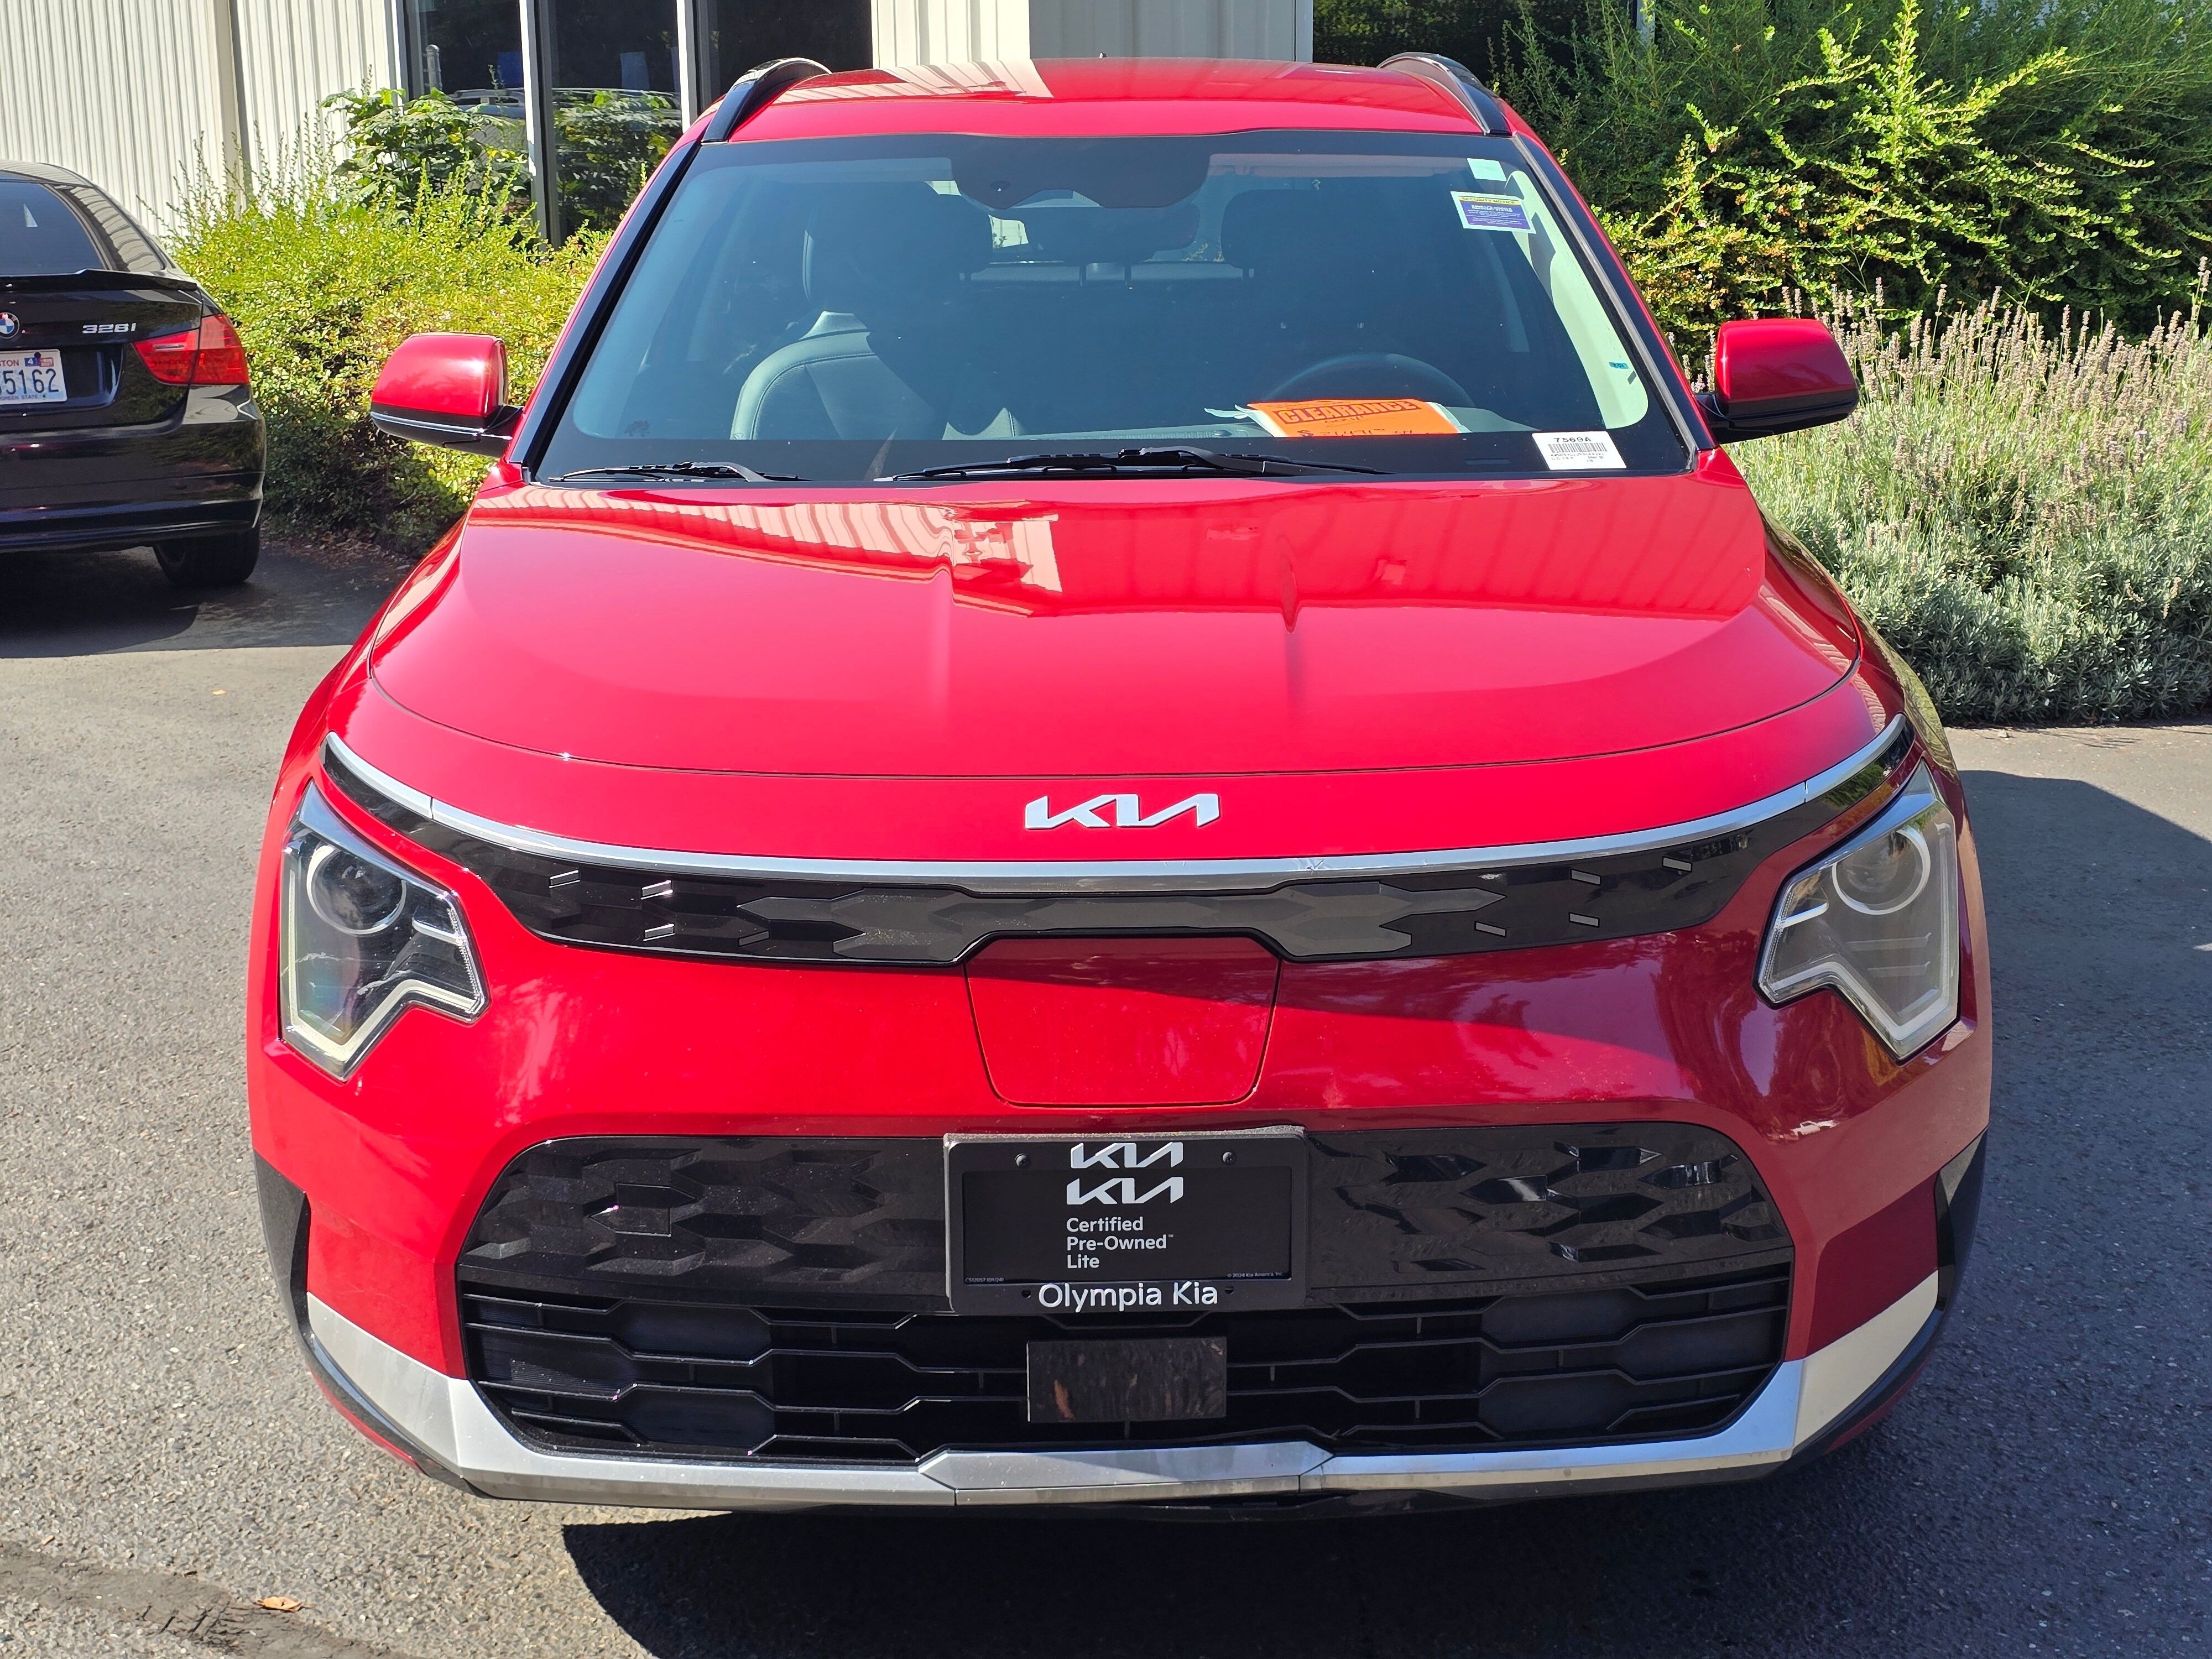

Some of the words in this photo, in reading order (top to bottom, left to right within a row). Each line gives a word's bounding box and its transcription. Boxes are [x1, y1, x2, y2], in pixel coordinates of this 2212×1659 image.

[0, 368, 59, 395] 5162
[1278, 401, 1417, 422] CLEARANCE
[1025, 793, 1220, 830] KIA
[1070, 1141, 1183, 1168] KIA
[1066, 1176, 1183, 1205] KIA
[1066, 1216, 1144, 1232] Certified
[1067, 1254, 1100, 1269] Lite
[1039, 1282, 1162, 1313] Olympia
[1173, 1281, 1218, 1305] Kia
